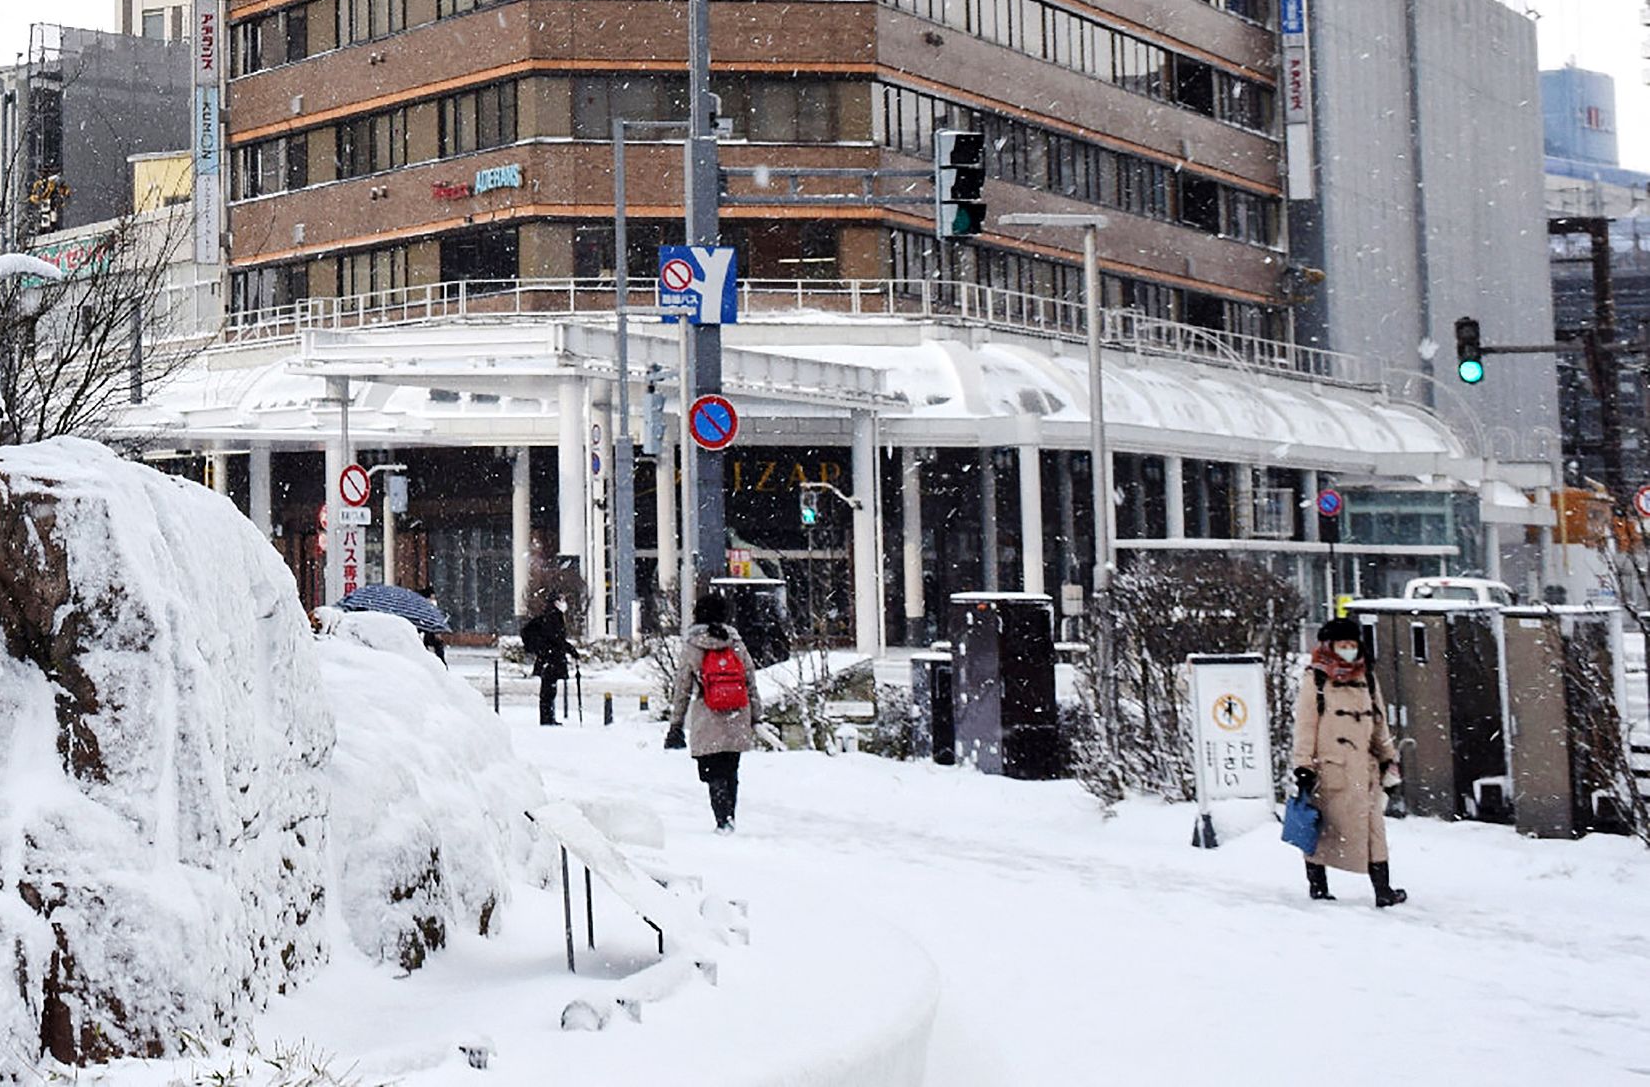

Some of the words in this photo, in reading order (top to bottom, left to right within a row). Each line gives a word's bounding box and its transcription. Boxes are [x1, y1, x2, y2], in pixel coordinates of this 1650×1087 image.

[202, 102, 213, 160] KUMON
[474, 163, 520, 195] ADERANS
[730, 460, 842, 493] IZAP
